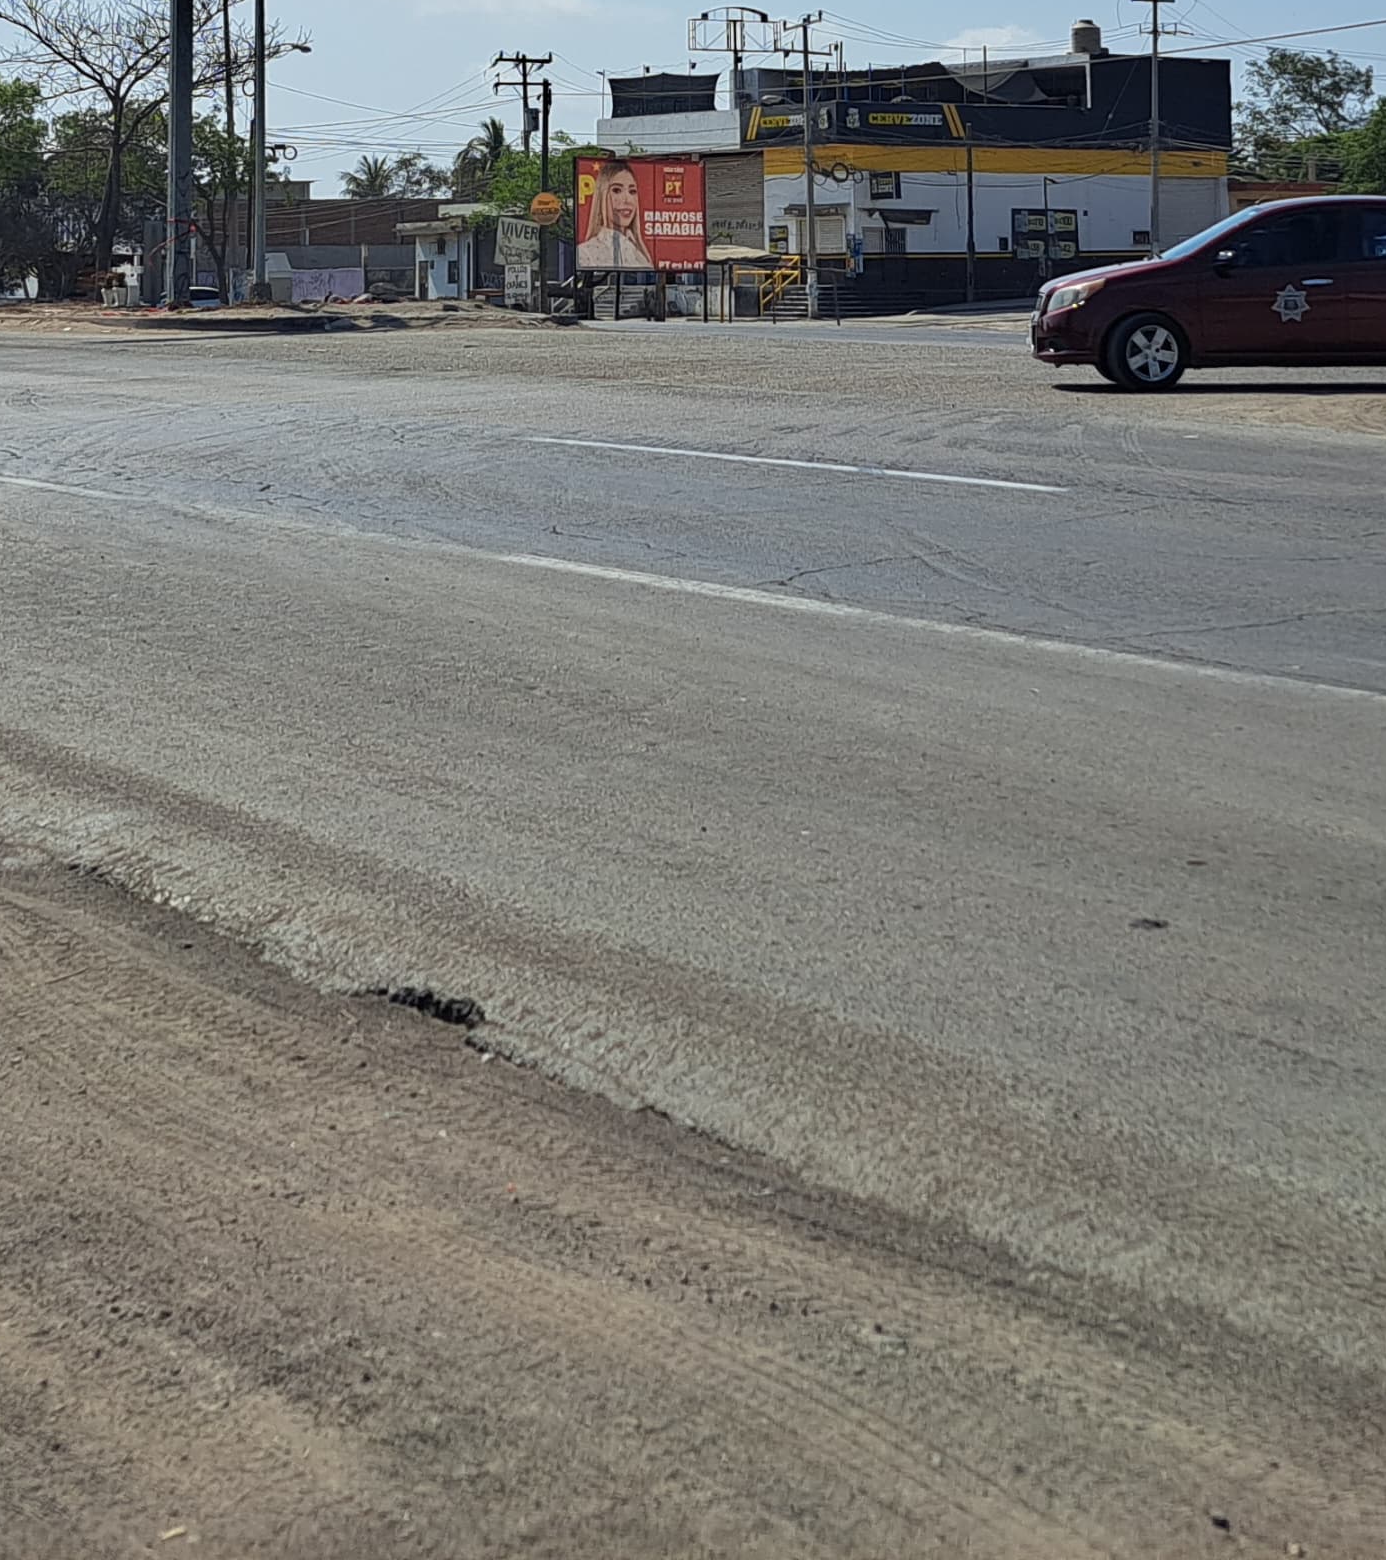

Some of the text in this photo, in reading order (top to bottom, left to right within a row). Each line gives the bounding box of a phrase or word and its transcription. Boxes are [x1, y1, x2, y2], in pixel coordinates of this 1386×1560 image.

[868, 113, 943, 126] CERVEZONE
[665, 181, 682, 195] PT
[644, 223, 705, 236] SARABIA
[658, 260, 671, 270] PT
[692, 261, 705, 270] 4T
